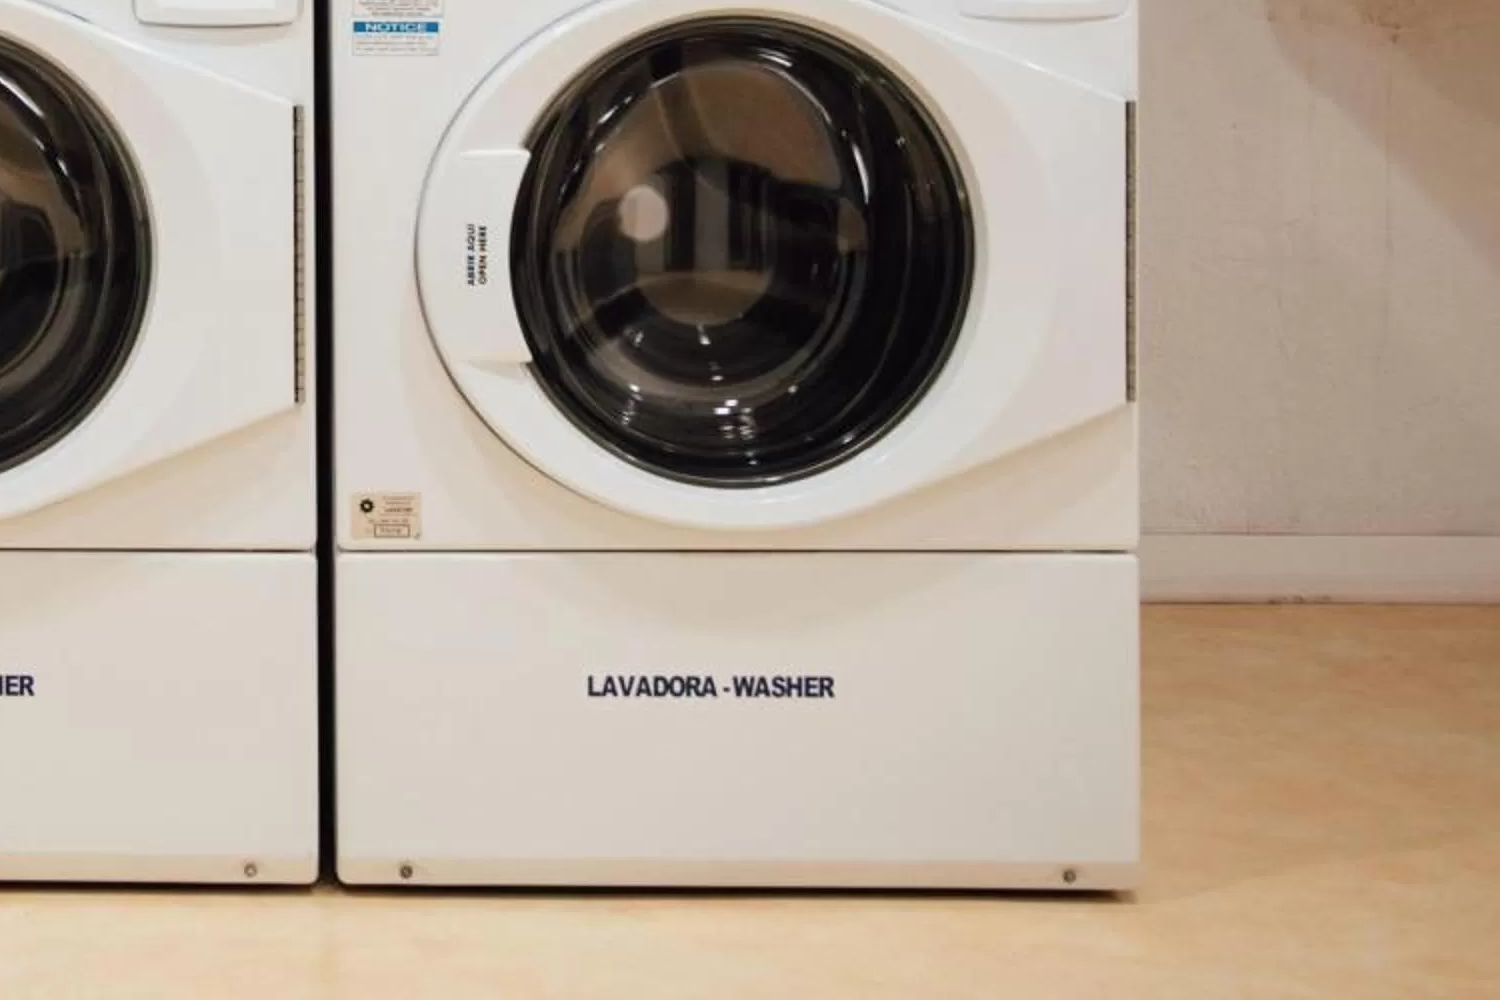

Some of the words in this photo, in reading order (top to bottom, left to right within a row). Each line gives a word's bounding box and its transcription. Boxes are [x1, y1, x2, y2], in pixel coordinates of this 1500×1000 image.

[365, 22, 426, 32] NOTICE
[587, 675, 718, 698] LAVADORA
[733, 675, 835, 699] WASHER
